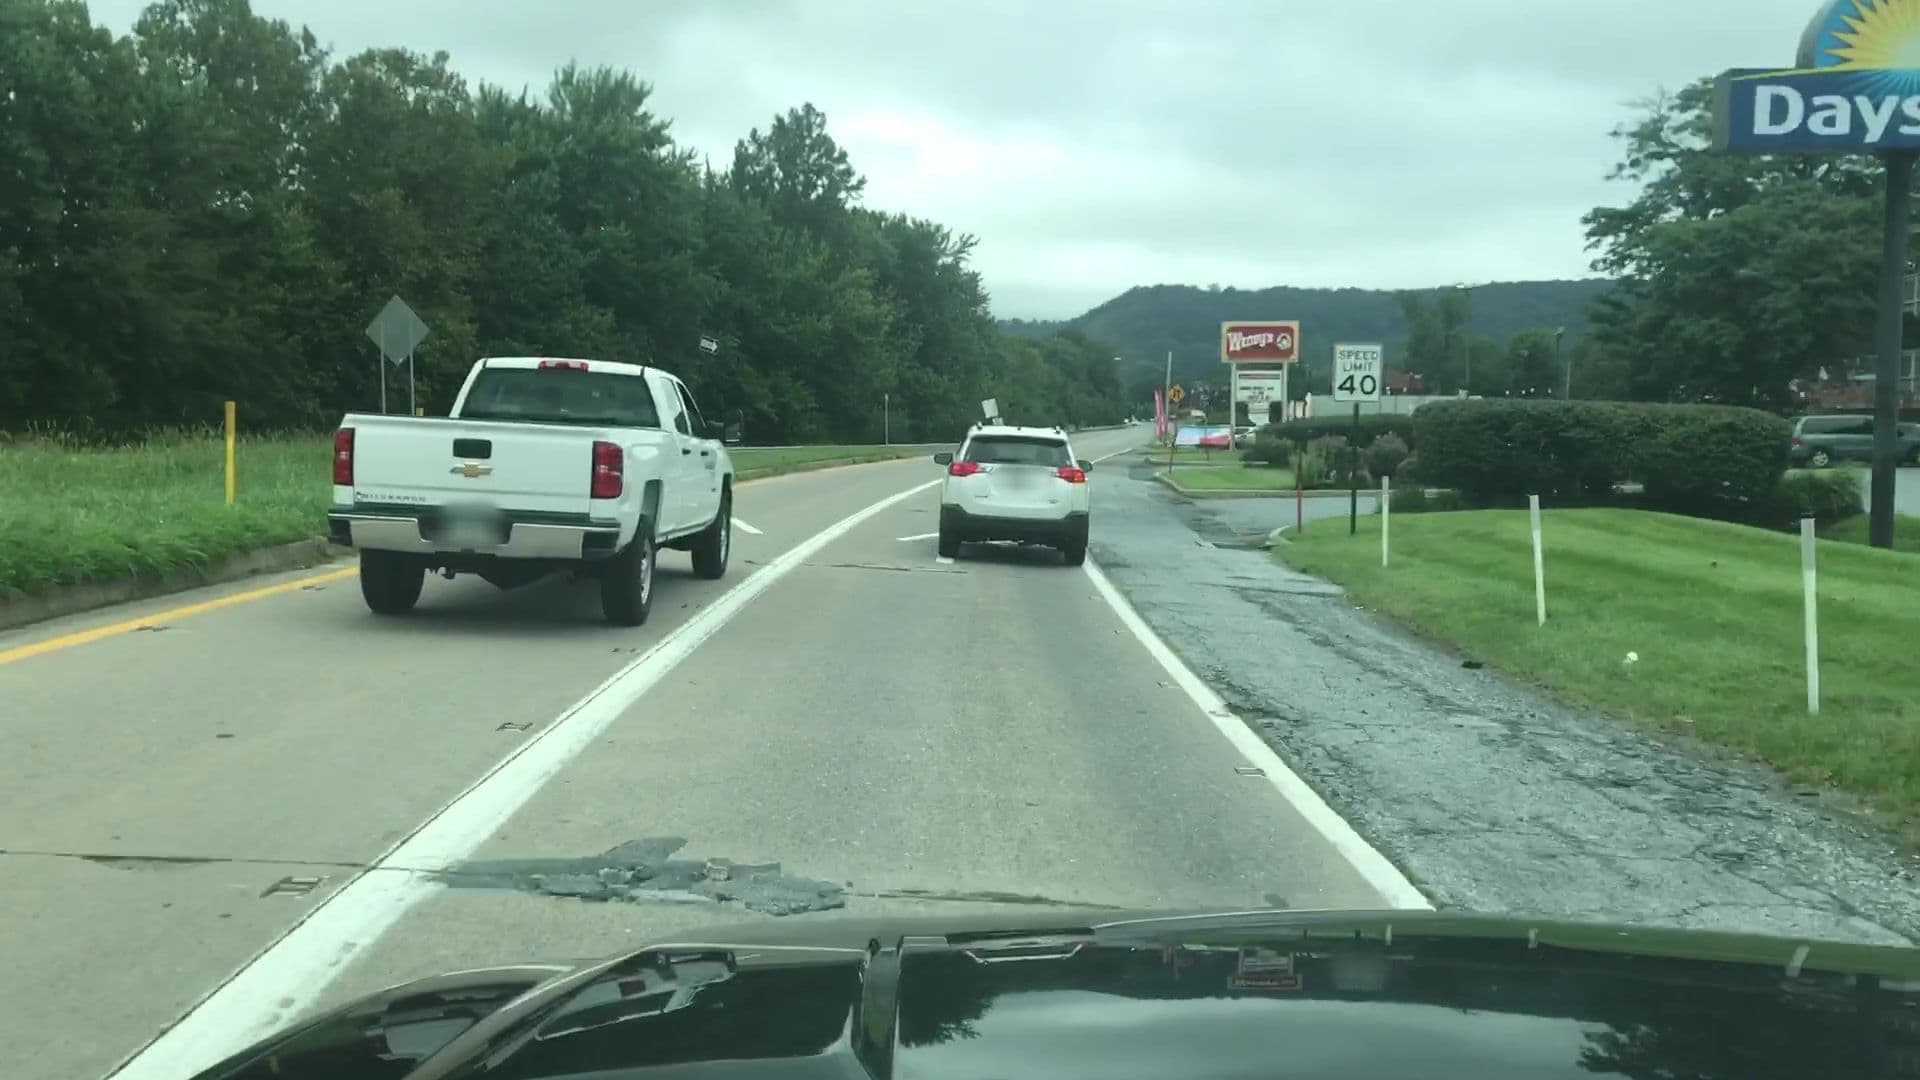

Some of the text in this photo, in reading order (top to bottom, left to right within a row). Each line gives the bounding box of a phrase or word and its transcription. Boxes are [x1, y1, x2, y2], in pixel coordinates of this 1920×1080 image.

[1337, 350, 1377, 360] SPEED
[1343, 361, 1372, 372] LIMIT
[1337, 374, 1377, 395] 40
